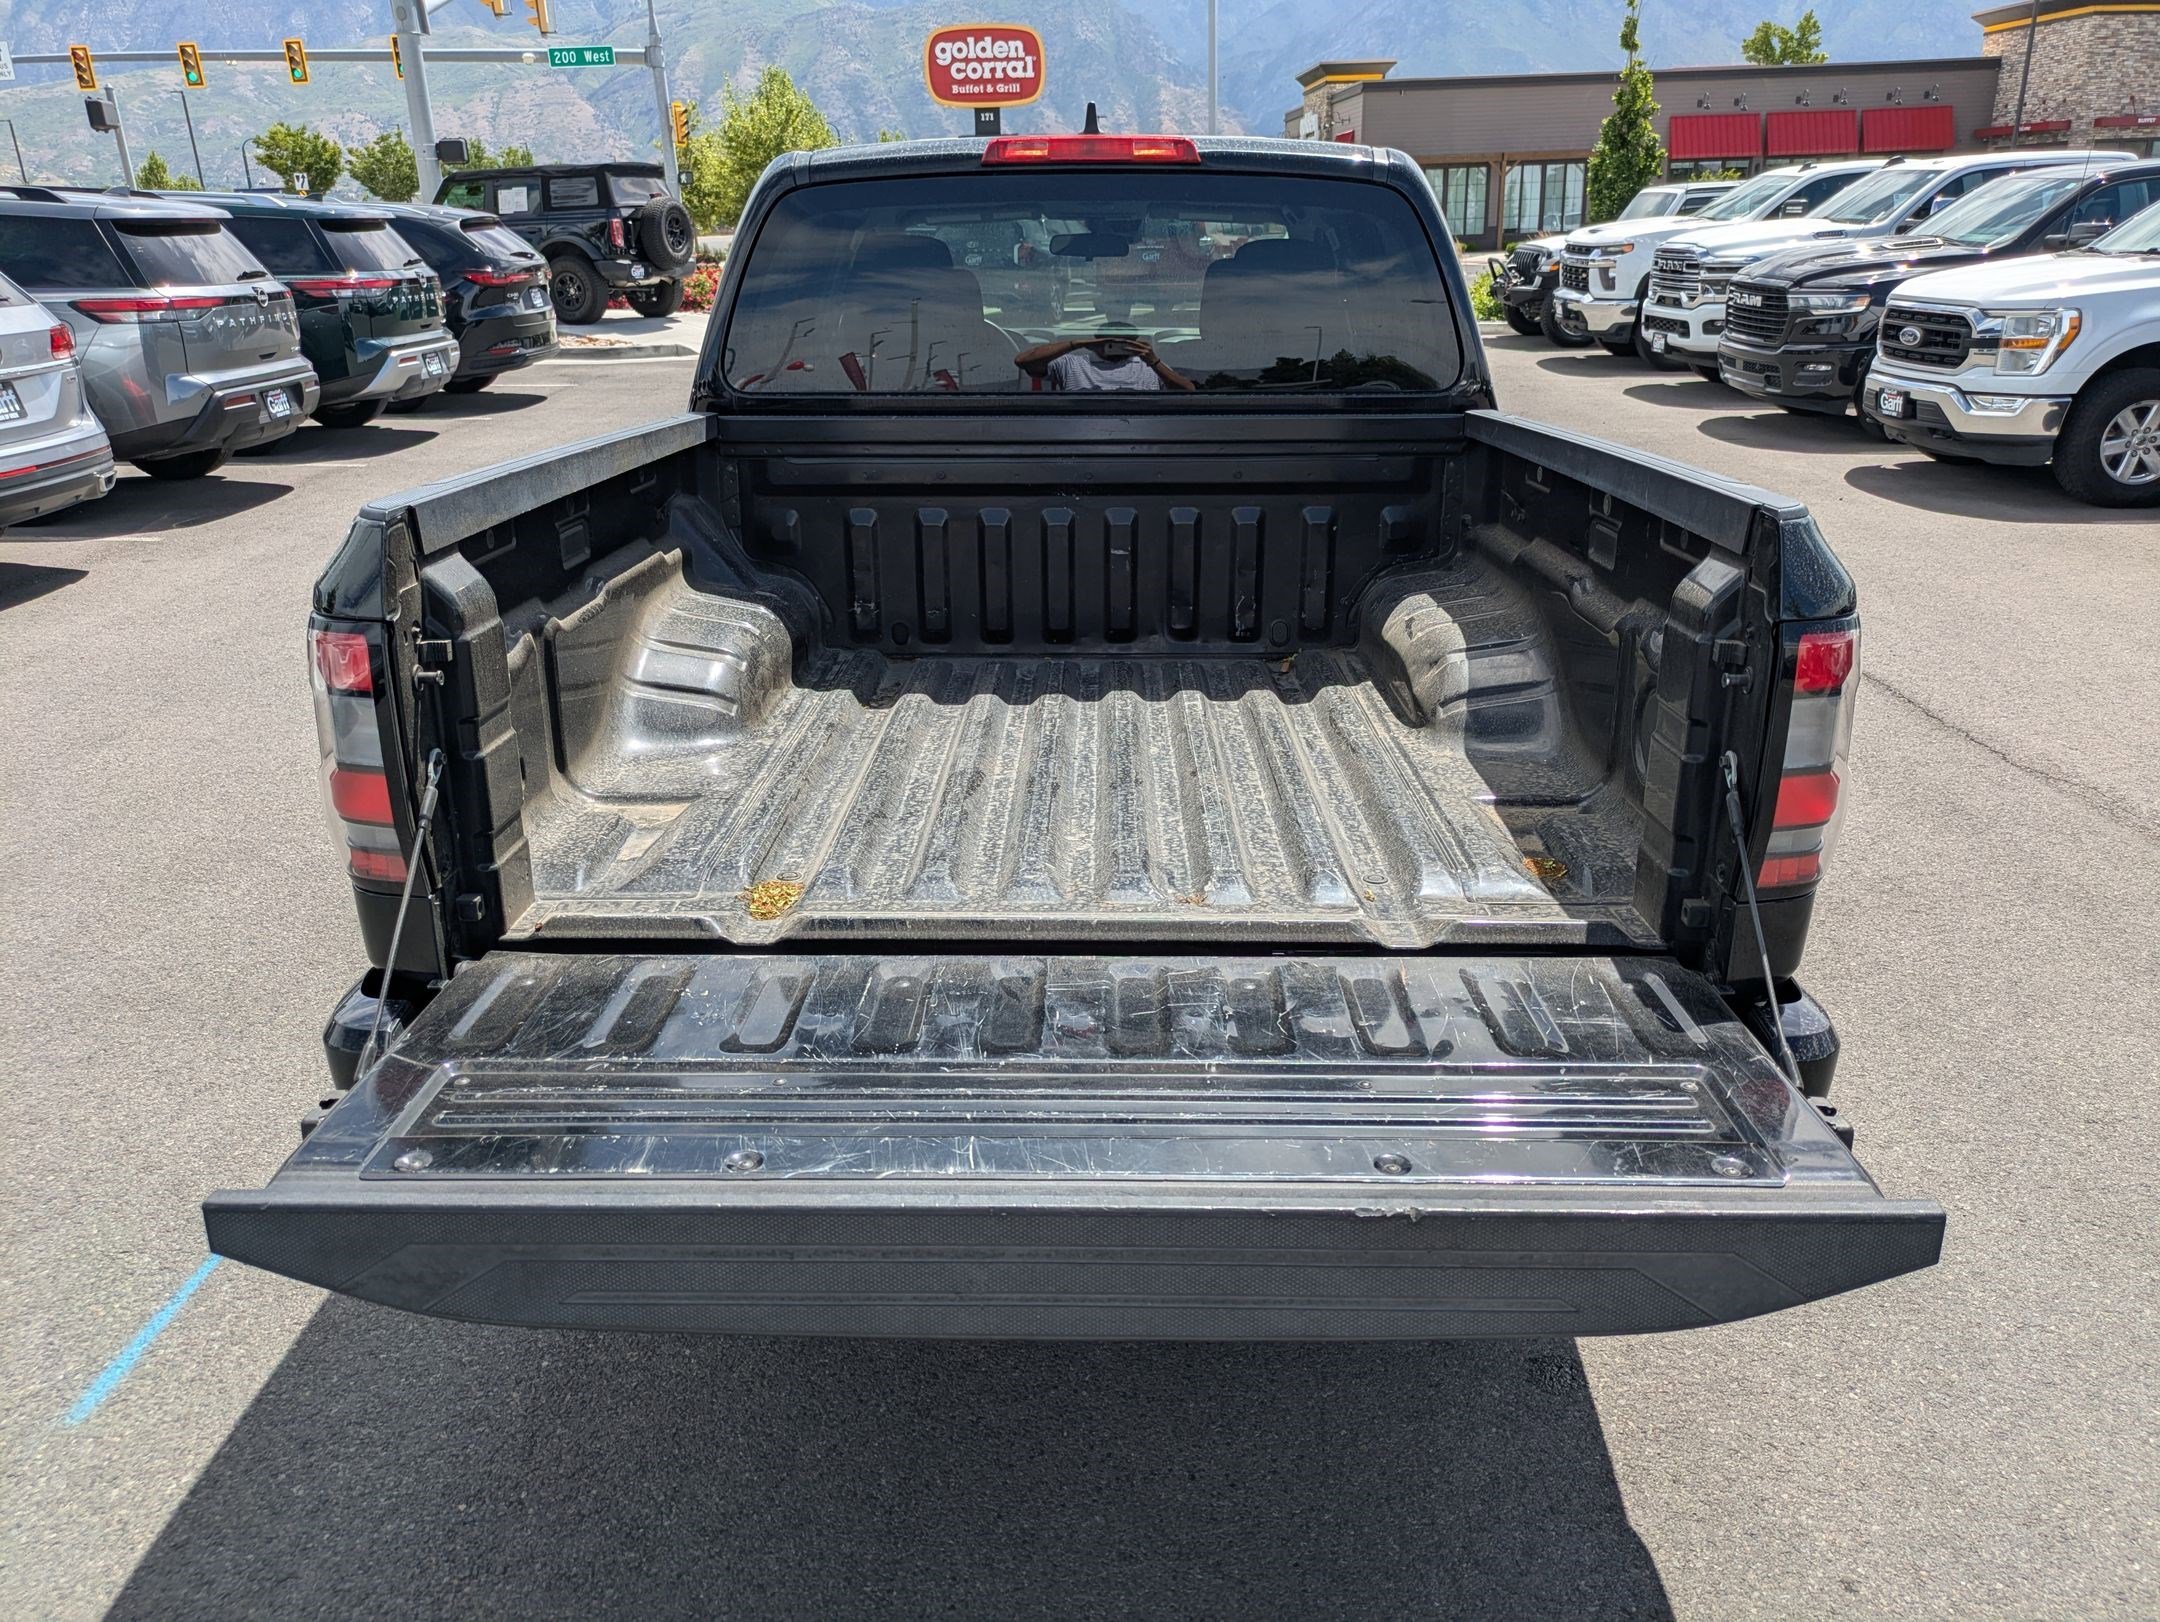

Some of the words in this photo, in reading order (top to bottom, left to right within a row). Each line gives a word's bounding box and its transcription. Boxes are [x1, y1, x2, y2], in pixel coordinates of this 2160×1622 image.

[553, 51, 576, 64] 200
[584, 50, 610, 63] West
[934, 36, 1025, 66] golden
[950, 55, 1034, 80] corral
[951, 84, 984, 94] Buffet
[986, 84, 994, 93] &
[996, 83, 1020, 93] Grill
[980, 112, 994, 121] 171
[1732, 291, 1762, 307] RAM
[0, 389, 20, 414] rff
[267, 392, 290, 414] Garff
[1880, 393, 1903, 413] Garff
